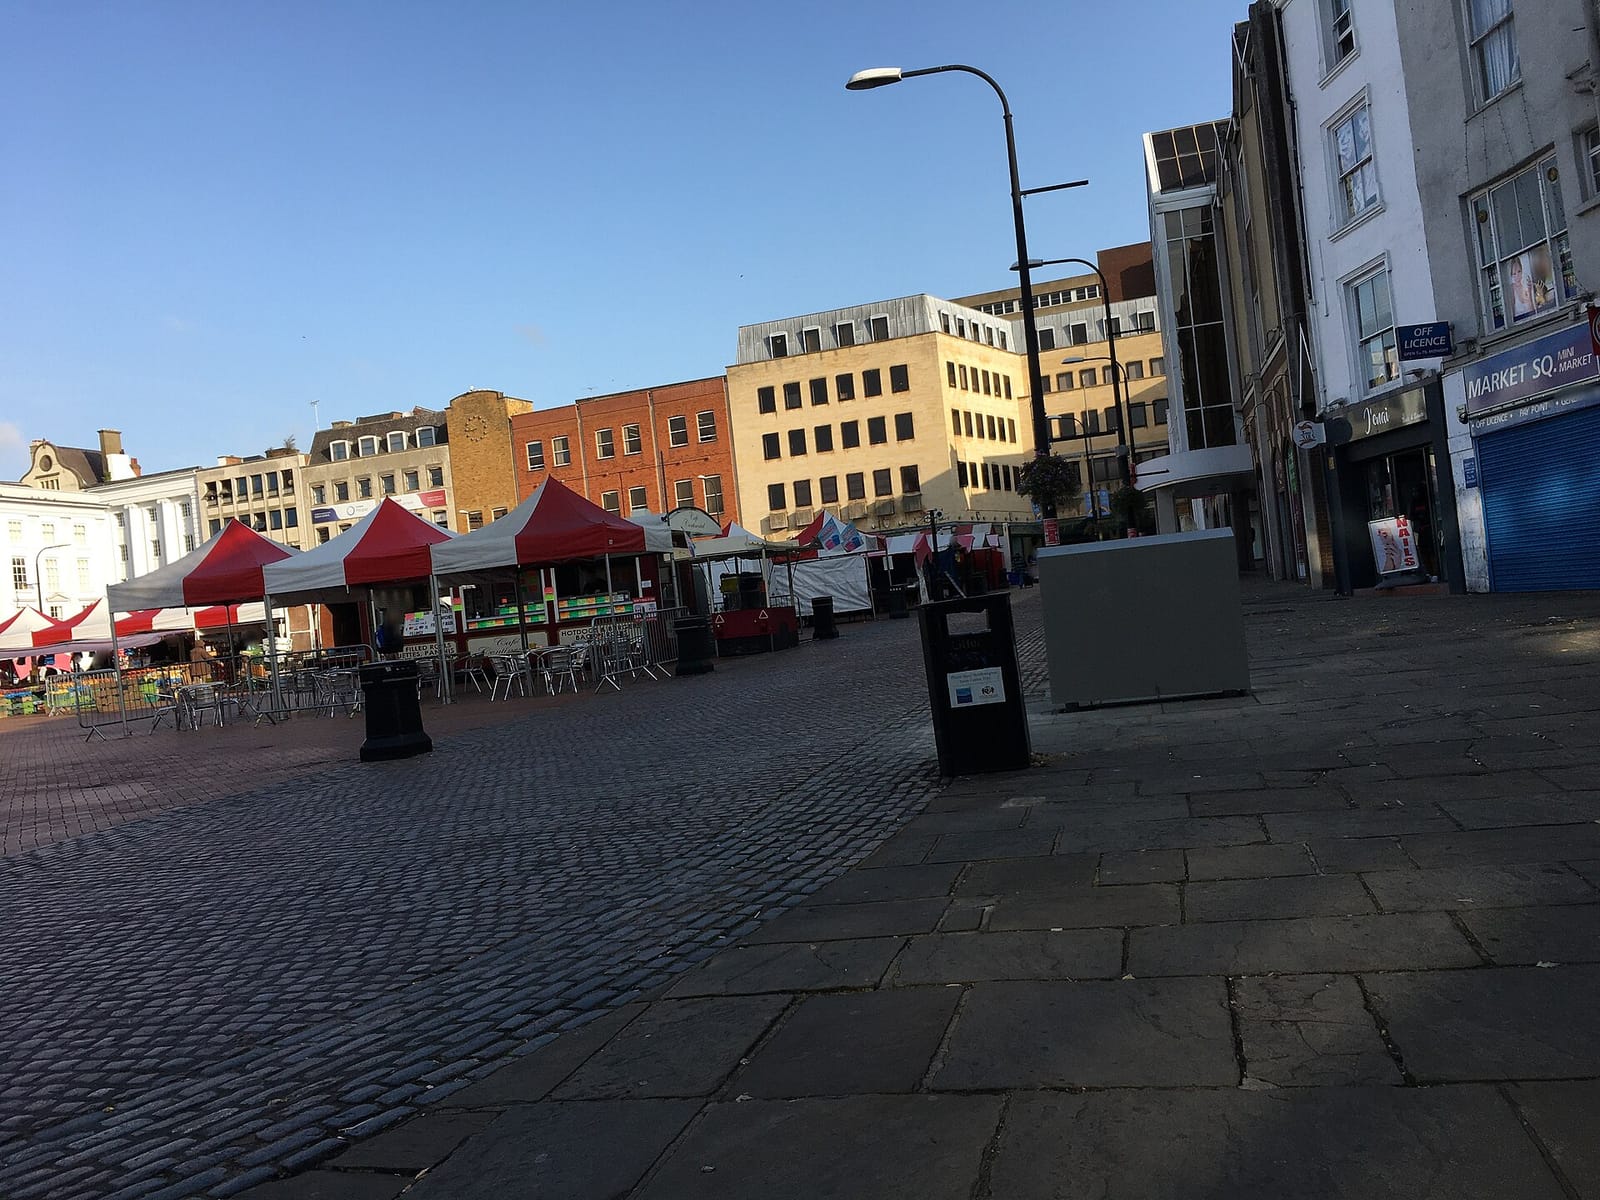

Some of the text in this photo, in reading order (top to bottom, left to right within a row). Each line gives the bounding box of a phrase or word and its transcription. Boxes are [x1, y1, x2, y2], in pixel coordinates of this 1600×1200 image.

[1413, 326, 1434, 337] OFF
[1404, 335, 1446, 349] LICENCE
[1557, 346, 1575, 360] MINI
[1558, 353, 1593, 373] MARKET
[1468, 354, 1557, 399] MARKET SQ.
[1475, 419, 1486, 429] OFF
[1486, 413, 1508, 427] LICENCE
[1519, 407, 1530, 417] PAY
[1530, 402, 1549, 414] POINT
[1396, 518, 1416, 567] NAILS
[405, 644, 428, 653] FILLED
